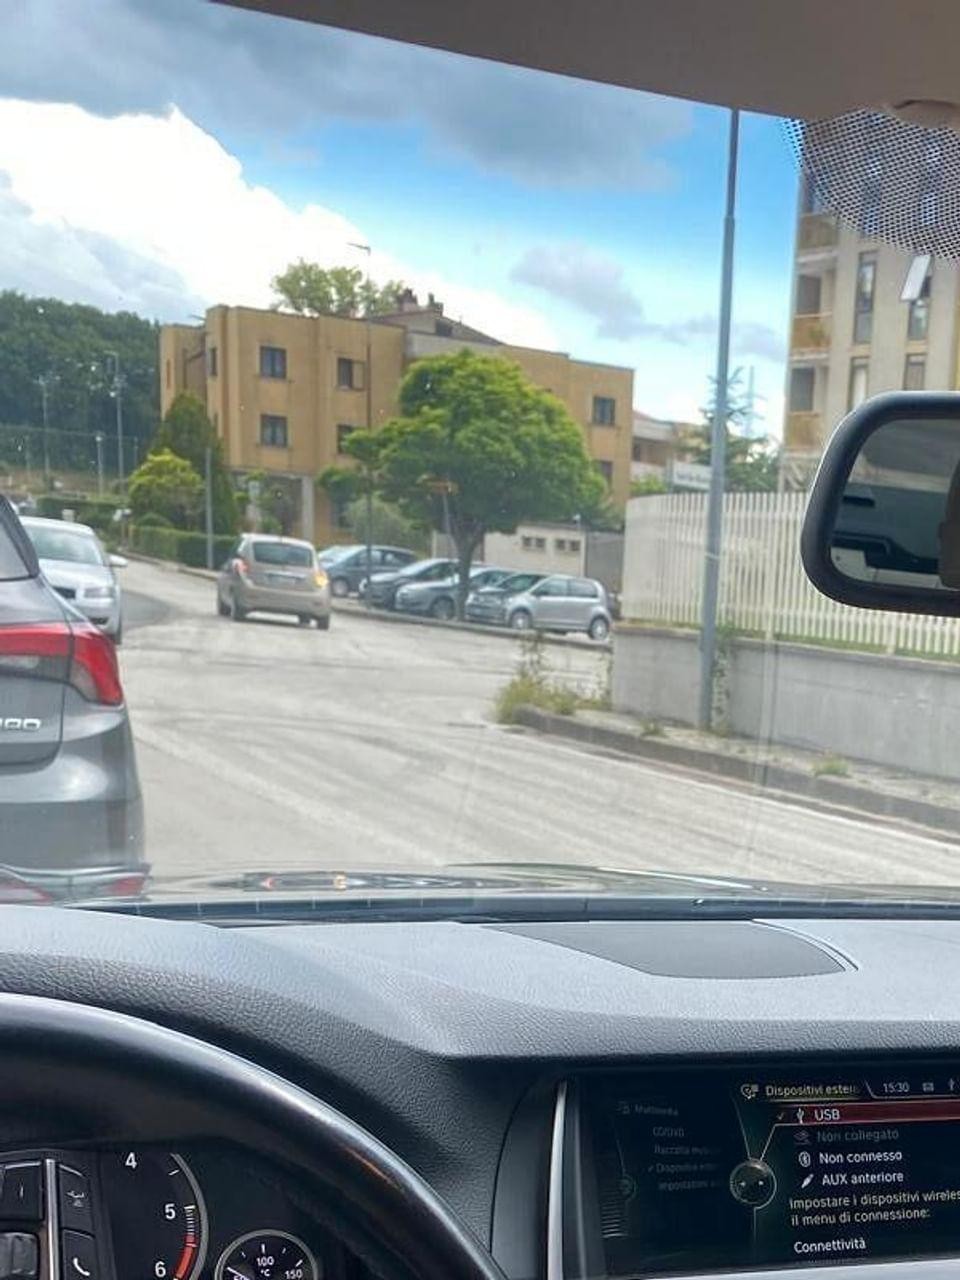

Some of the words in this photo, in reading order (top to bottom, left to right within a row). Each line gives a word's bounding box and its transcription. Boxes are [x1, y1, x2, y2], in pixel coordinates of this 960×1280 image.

[765, 1084, 824, 1098] Dispositivi
[814, 1109, 840, 1121] USB
[817, 1130, 842, 1142] Non
[845, 1129, 900, 1143] collegato
[125, 1152, 138, 1169] 4
[819, 1152, 844, 1165] Non
[846, 1151, 903, 1164] connesso
[822, 1173, 848, 1187] AUX
[850, 1172, 904, 1185] anteriore
[789, 1196, 851, 1210] Impostare
[860, 1191, 921, 1206] dispositivi
[164, 1203, 177, 1220] 5
[802, 1214, 837, 1226] menu
[838, 1210, 851, 1223] di
[854, 1208, 931, 1223] connessione:
[793, 1236, 867, 1254] Connettività
[256, 1256, 275, 1267] 100
[154, 1261, 167, 1278] 6
[285, 1268, 304, 1280] 150
